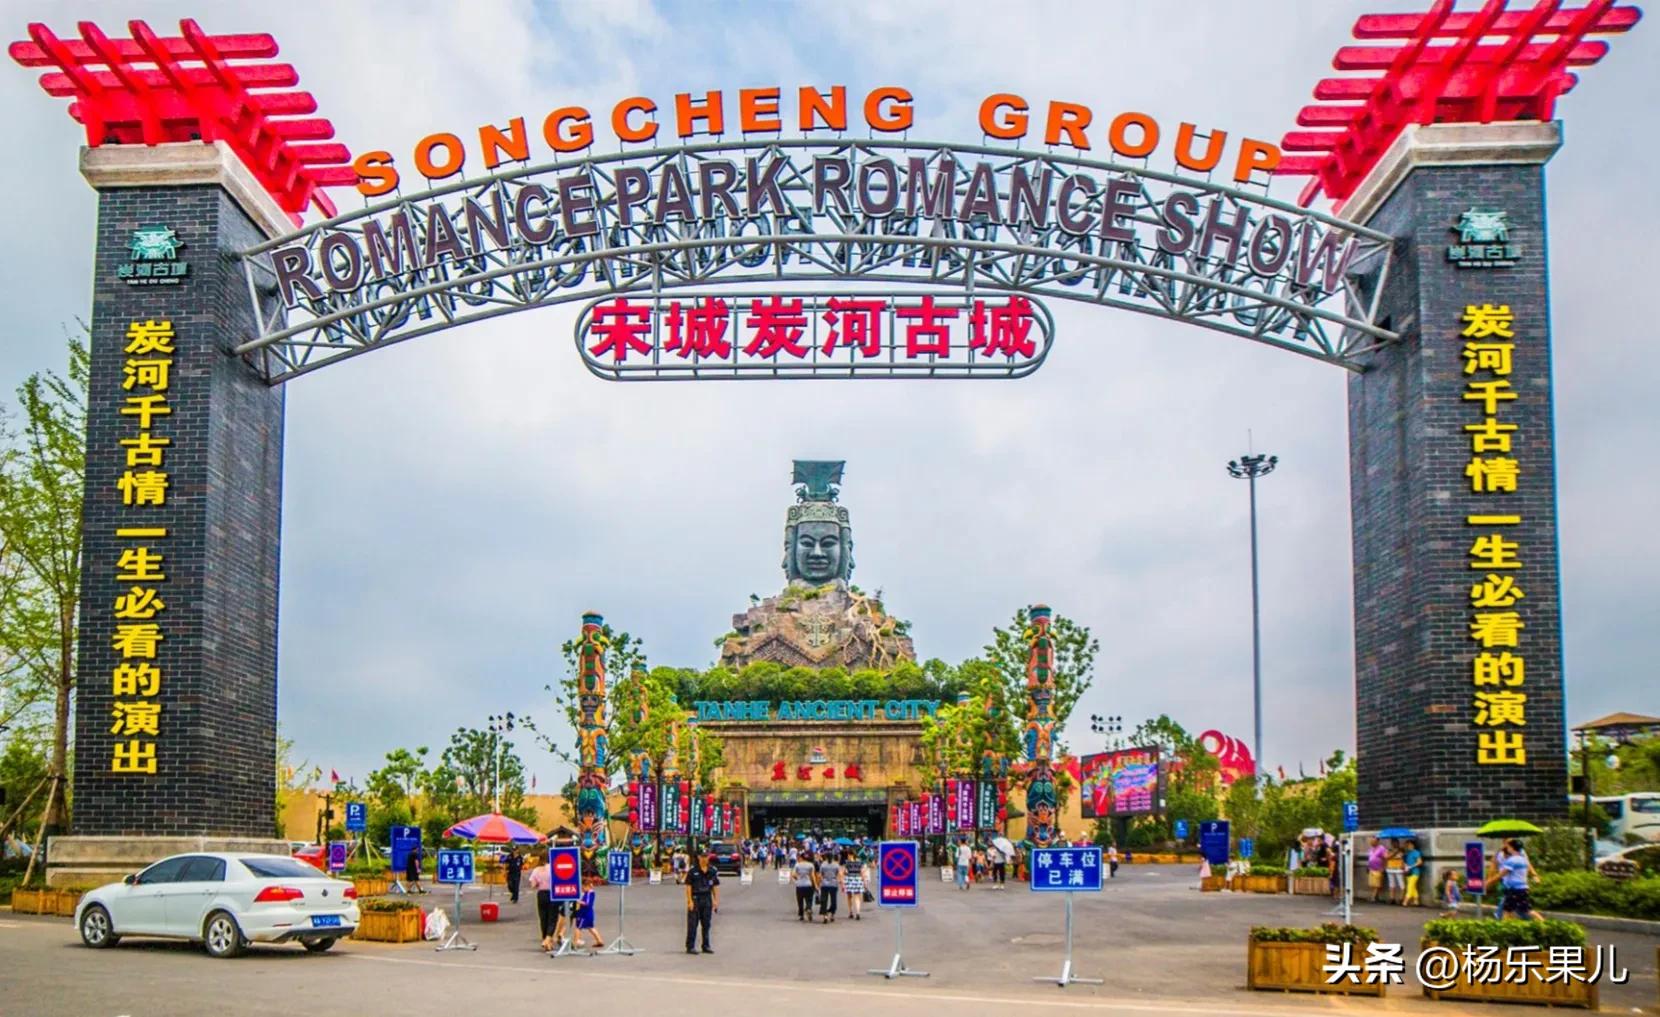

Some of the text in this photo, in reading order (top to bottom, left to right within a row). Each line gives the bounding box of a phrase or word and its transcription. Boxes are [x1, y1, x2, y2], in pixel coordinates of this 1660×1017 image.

[352, 85, 1282, 197] SONGCHENG GROUP
[269, 174, 600, 311] ROMANCE
[613, 154, 791, 228] PARK
[812, 153, 1143, 243] ROMANCE
[1156, 190, 1361, 296] SHOW
[590, 295, 1036, 360] 宋城炭河古城
[1461, 302, 1521, 493] 炭河千古情
[110, 318, 175, 776] 炭河千古情 一生必看的演出
[1467, 514, 1528, 767] 一生必看的演出
[694, 699, 941, 721] TANHE ANCIENT CITY
[350, 804, 360, 817] P
[441, 855, 471, 866] 停车位
[1037, 852, 1097, 868] 停车位
[1048, 869, 1085, 886] 已满
